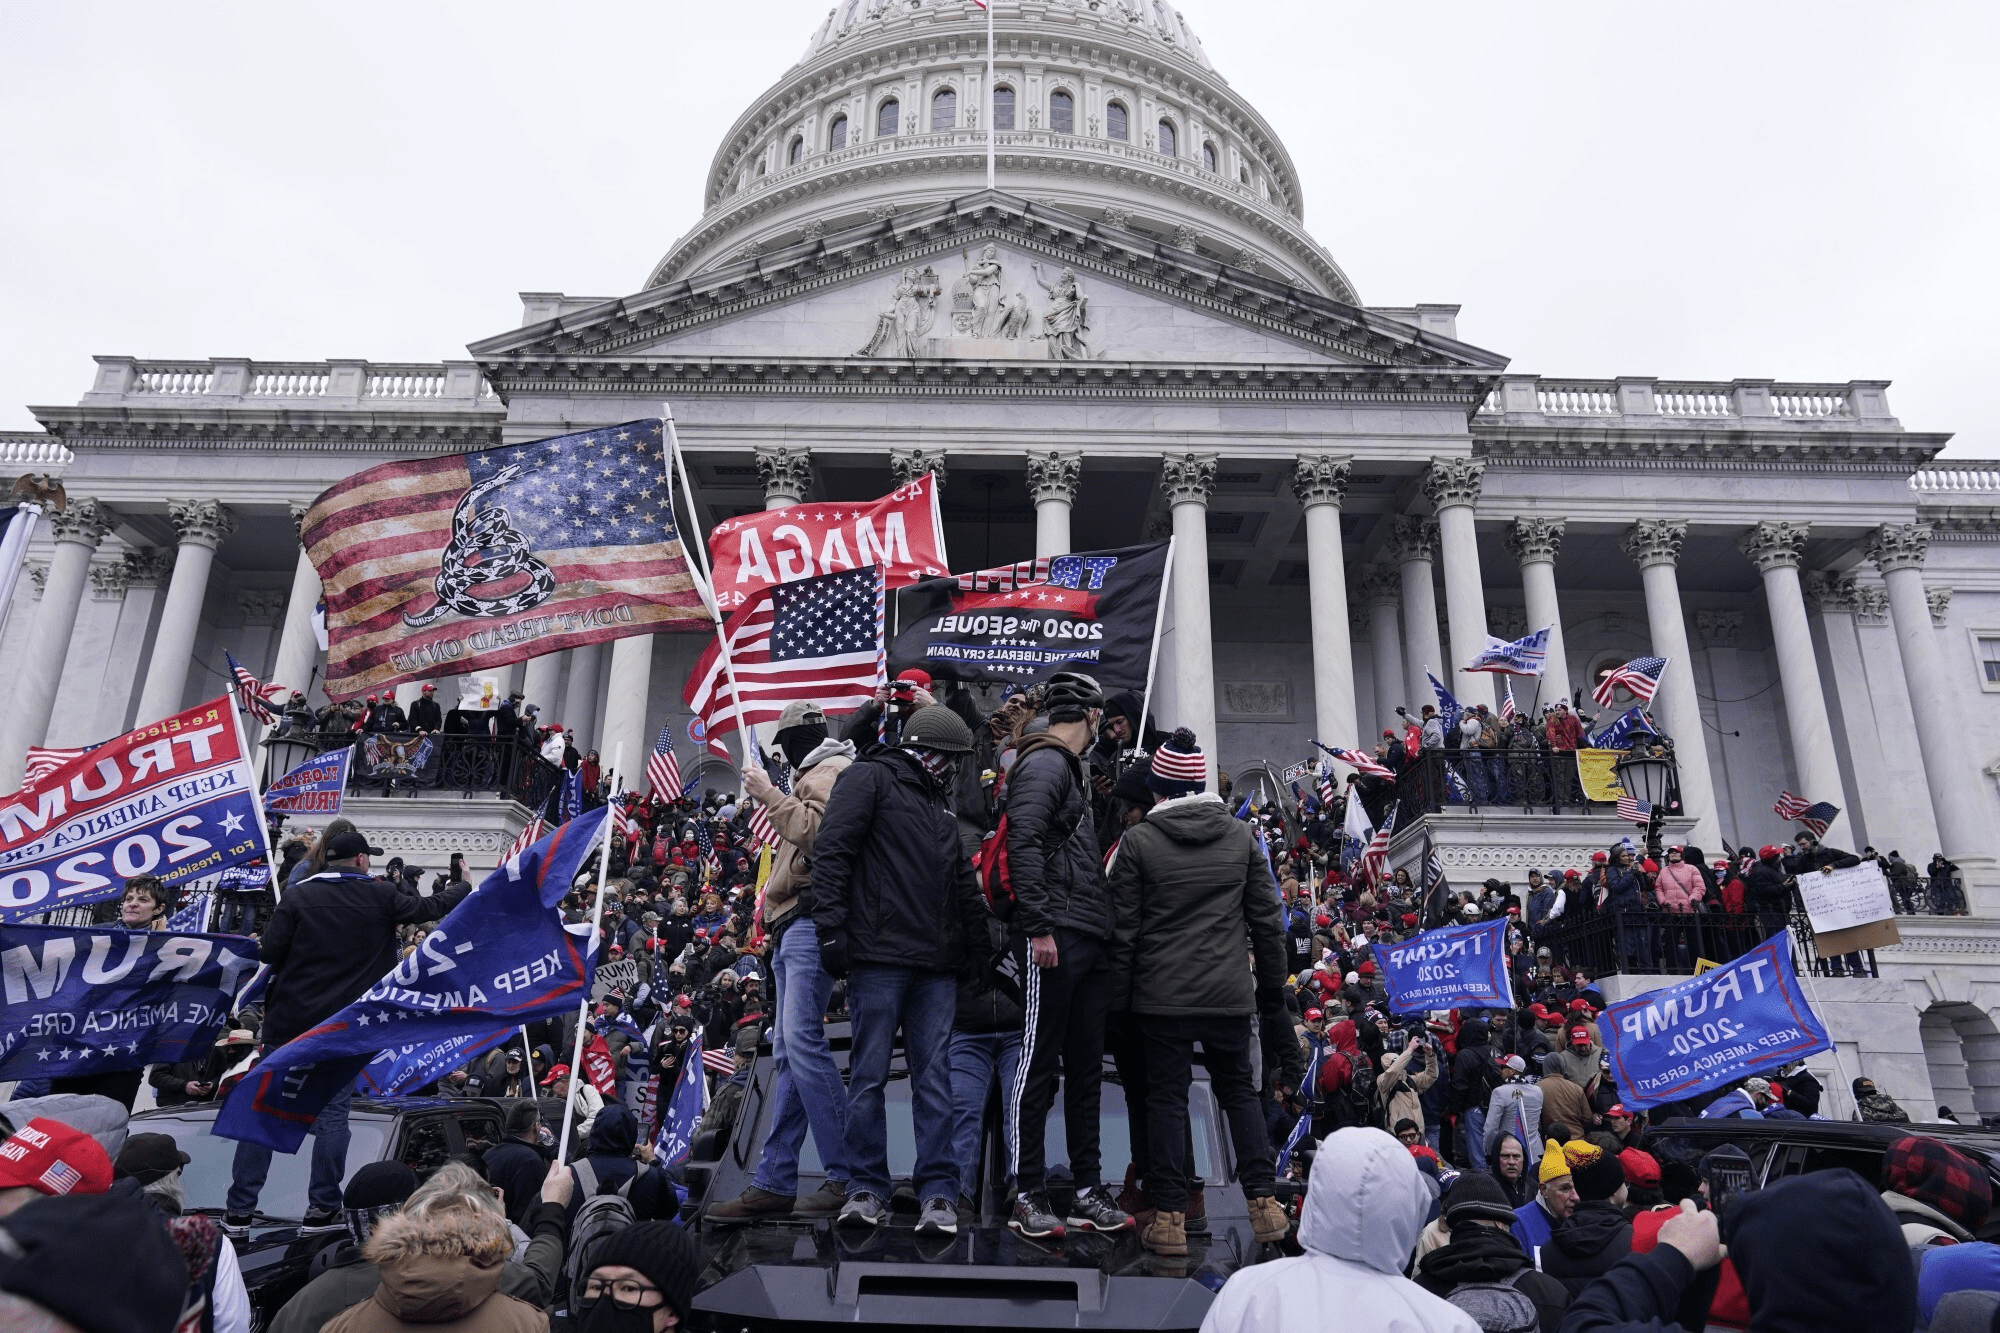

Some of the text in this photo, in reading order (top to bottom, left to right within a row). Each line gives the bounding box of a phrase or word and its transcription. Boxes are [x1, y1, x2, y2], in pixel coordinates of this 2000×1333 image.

[222, 872, 266, 882] SWAMP
[251, 868, 269, 876] THE
[595, 961, 635, 982] RUMP
